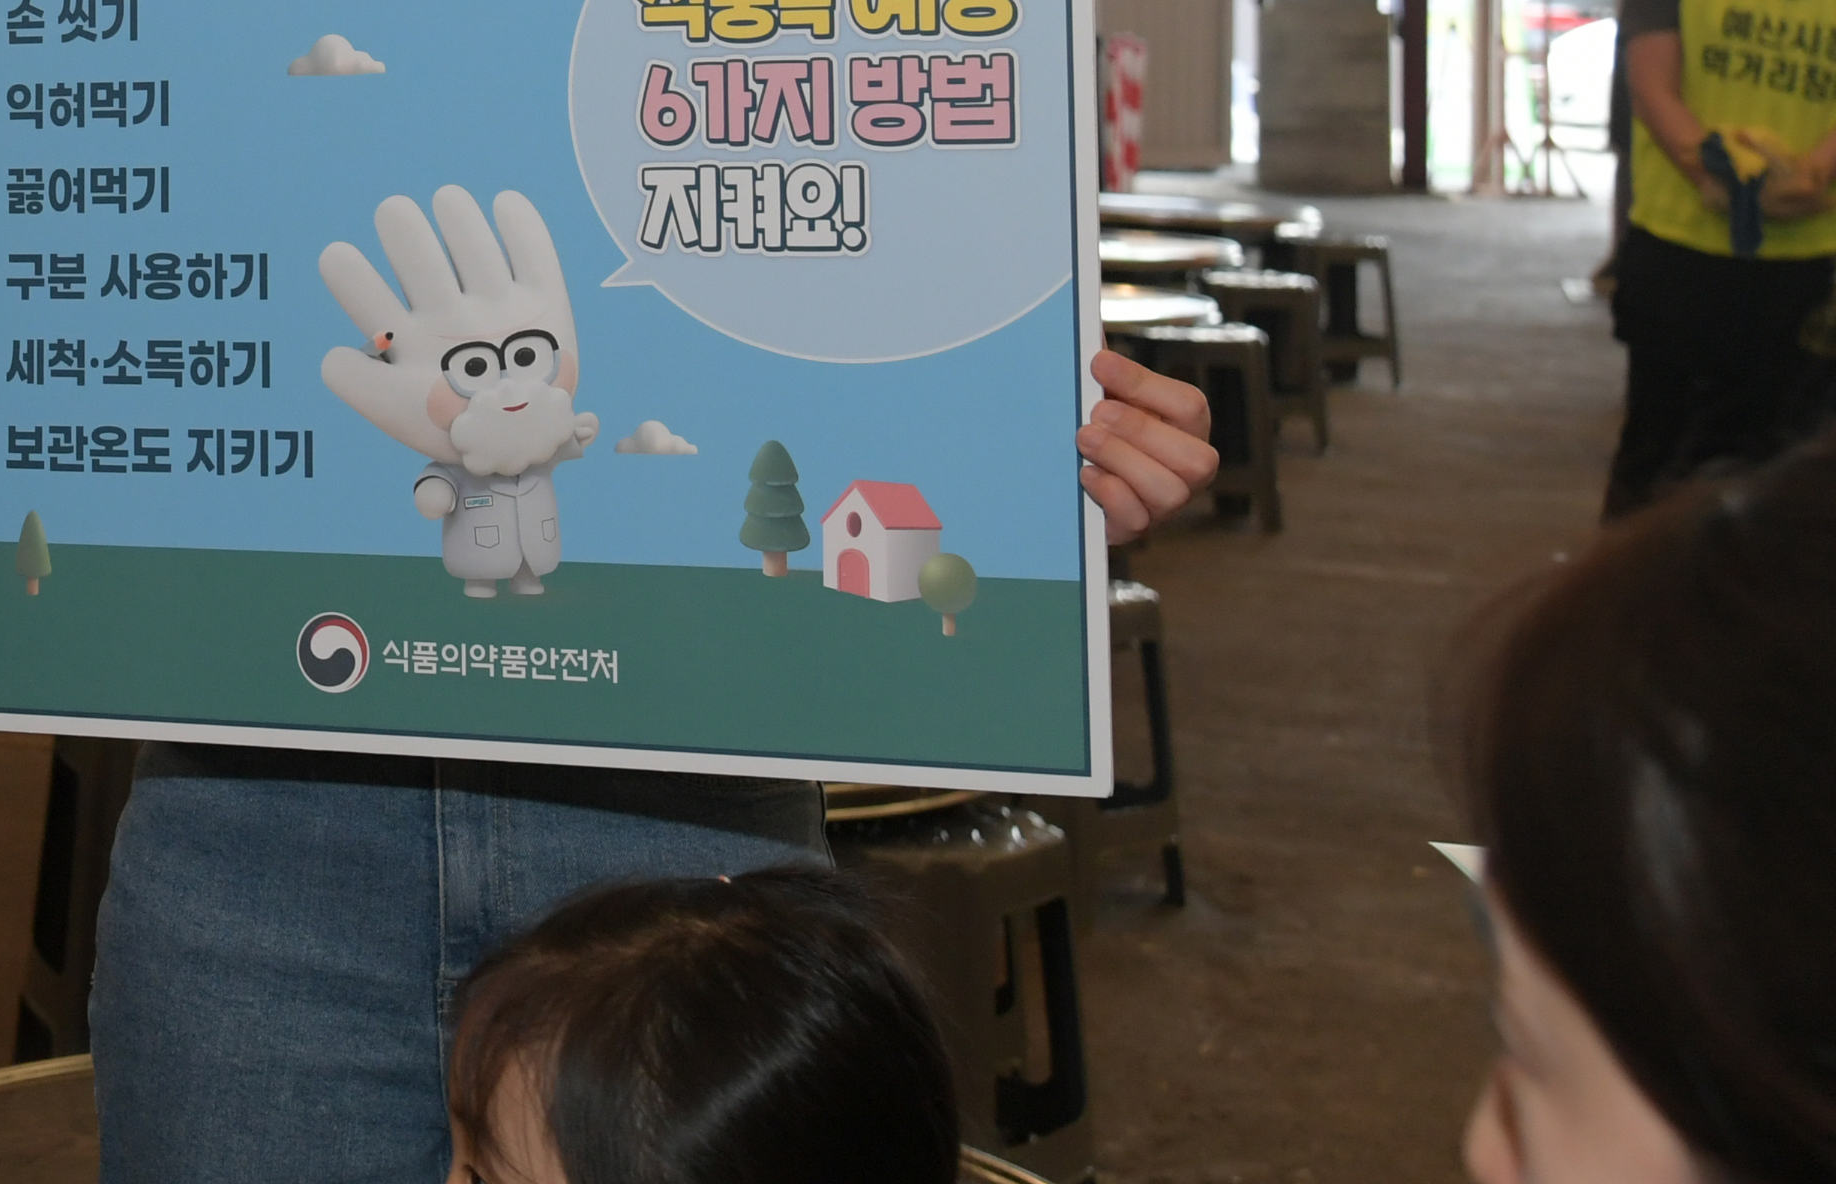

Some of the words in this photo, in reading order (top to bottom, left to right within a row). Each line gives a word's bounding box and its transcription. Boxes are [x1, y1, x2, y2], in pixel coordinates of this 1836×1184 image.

[1721, 6, 1836, 64] 예산시
[1702, 44, 1836, 102] 먹거리장
[6, 79, 170, 129] 익혀먹기
[639, 56, 835, 148] 6가지
[848, 52, 1016, 148] 방법
[6, 166, 170, 215] 끓여먹기
[639, 161, 867, 253] 지켜요!
[6, 252, 86, 300] 구분
[100, 252, 268, 301] 사용하기
[6, 338, 271, 389] 세척·소독하기
[5, 425, 172, 474] 보관온도
[186, 428, 314, 478] 지키기
[381, 639, 619, 685] 식품의약품안전처
